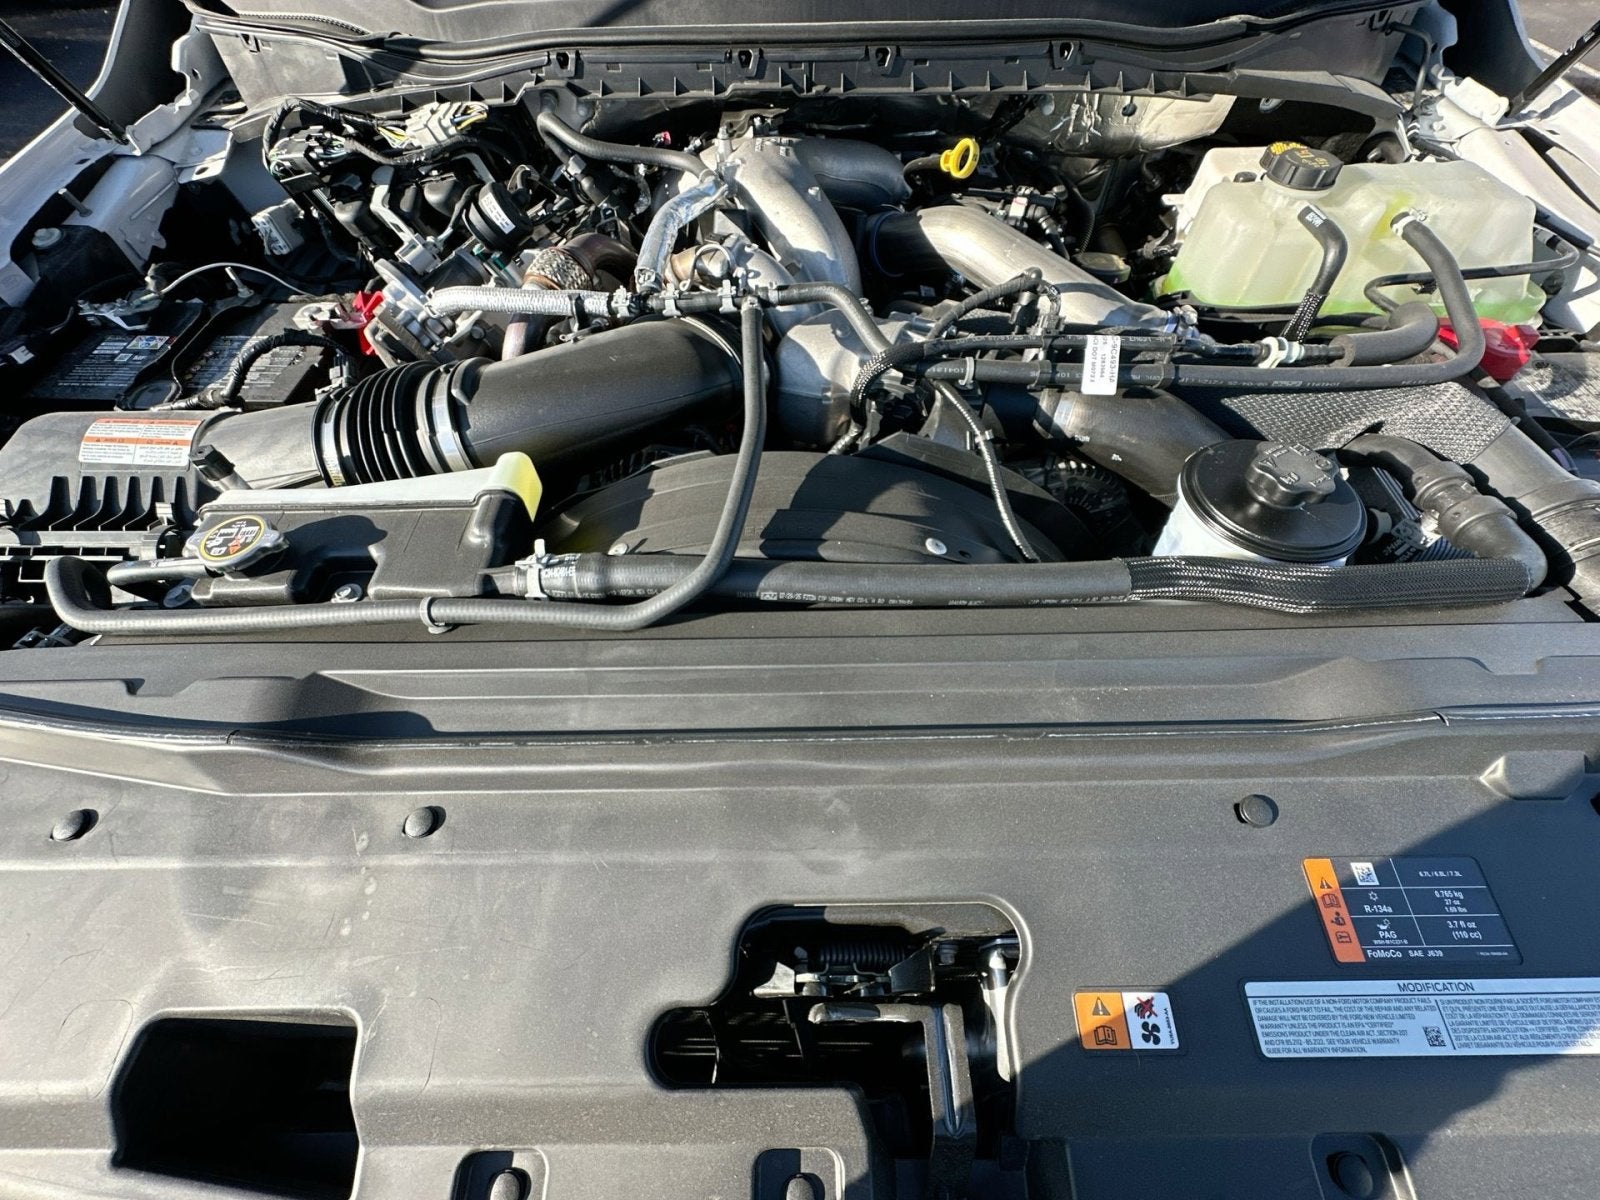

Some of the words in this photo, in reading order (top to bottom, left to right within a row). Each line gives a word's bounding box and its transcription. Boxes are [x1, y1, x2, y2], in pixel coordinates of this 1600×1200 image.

[1454, 890, 1464, 899] kg
[1364, 905, 1393, 913] R-134a
[1446, 920, 1458, 928] 3.7
[1378, 931, 1398, 939] PAG
[1452, 931, 1469, 940] (110
[1469, 932, 1482, 940] cc)
[1366, 949, 1402, 958] FoMoCo
[1397, 982, 1475, 993] MODIFICATION
